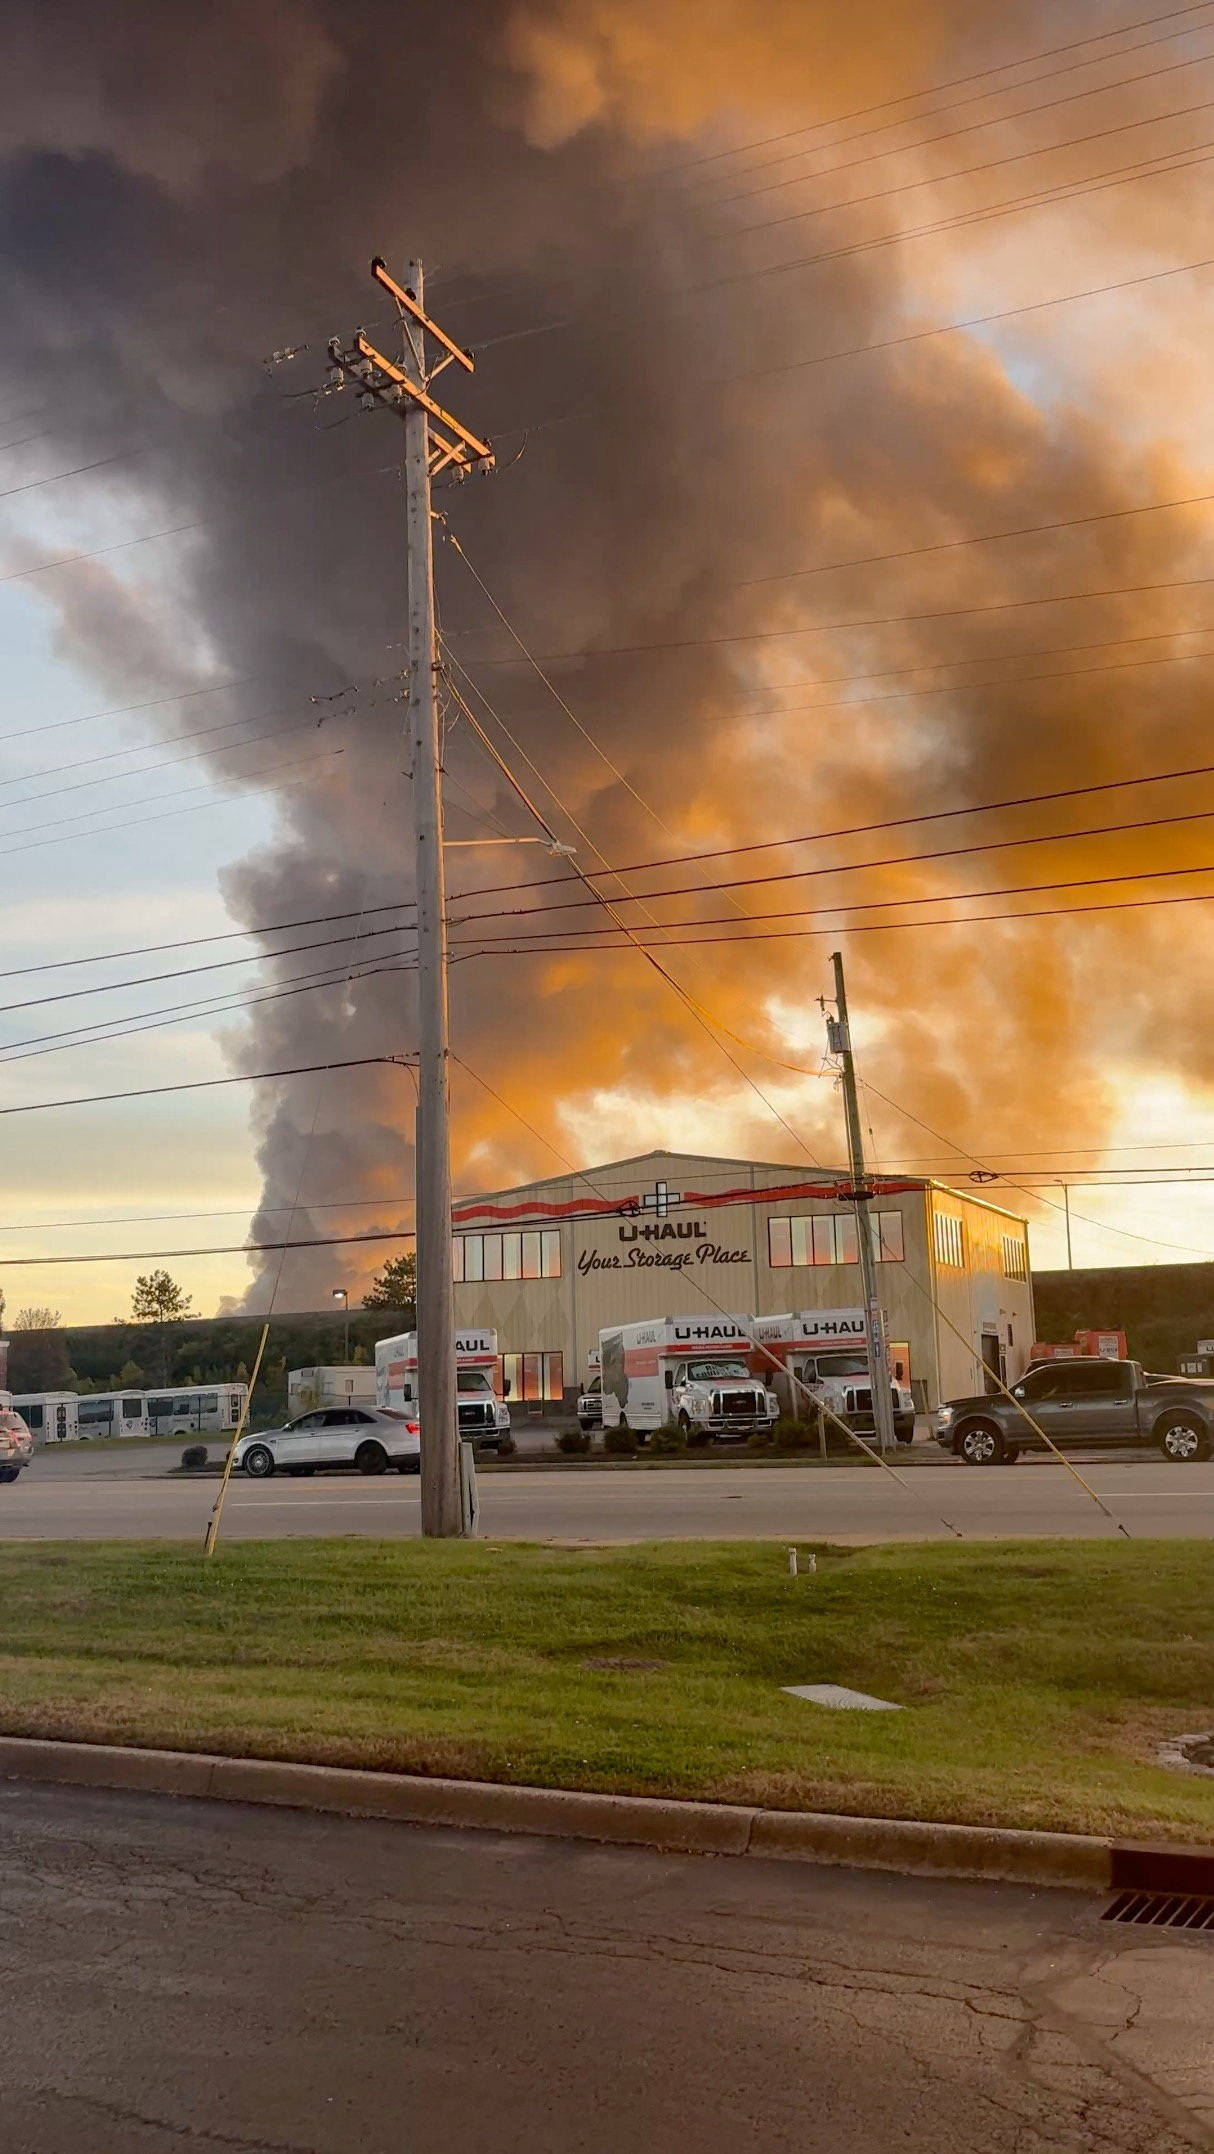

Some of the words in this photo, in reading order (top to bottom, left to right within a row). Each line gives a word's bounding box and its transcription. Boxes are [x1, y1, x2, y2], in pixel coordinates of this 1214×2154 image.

[619, 1222, 706, 1242] U-HAUL
[578, 1250, 622, 1276] Your
[623, 1248, 694, 1271] Storage
[696, 1243, 752, 1264] Place
[803, 1320, 864, 1335] U-HAU
[456, 1340, 490, 1351] AUL
